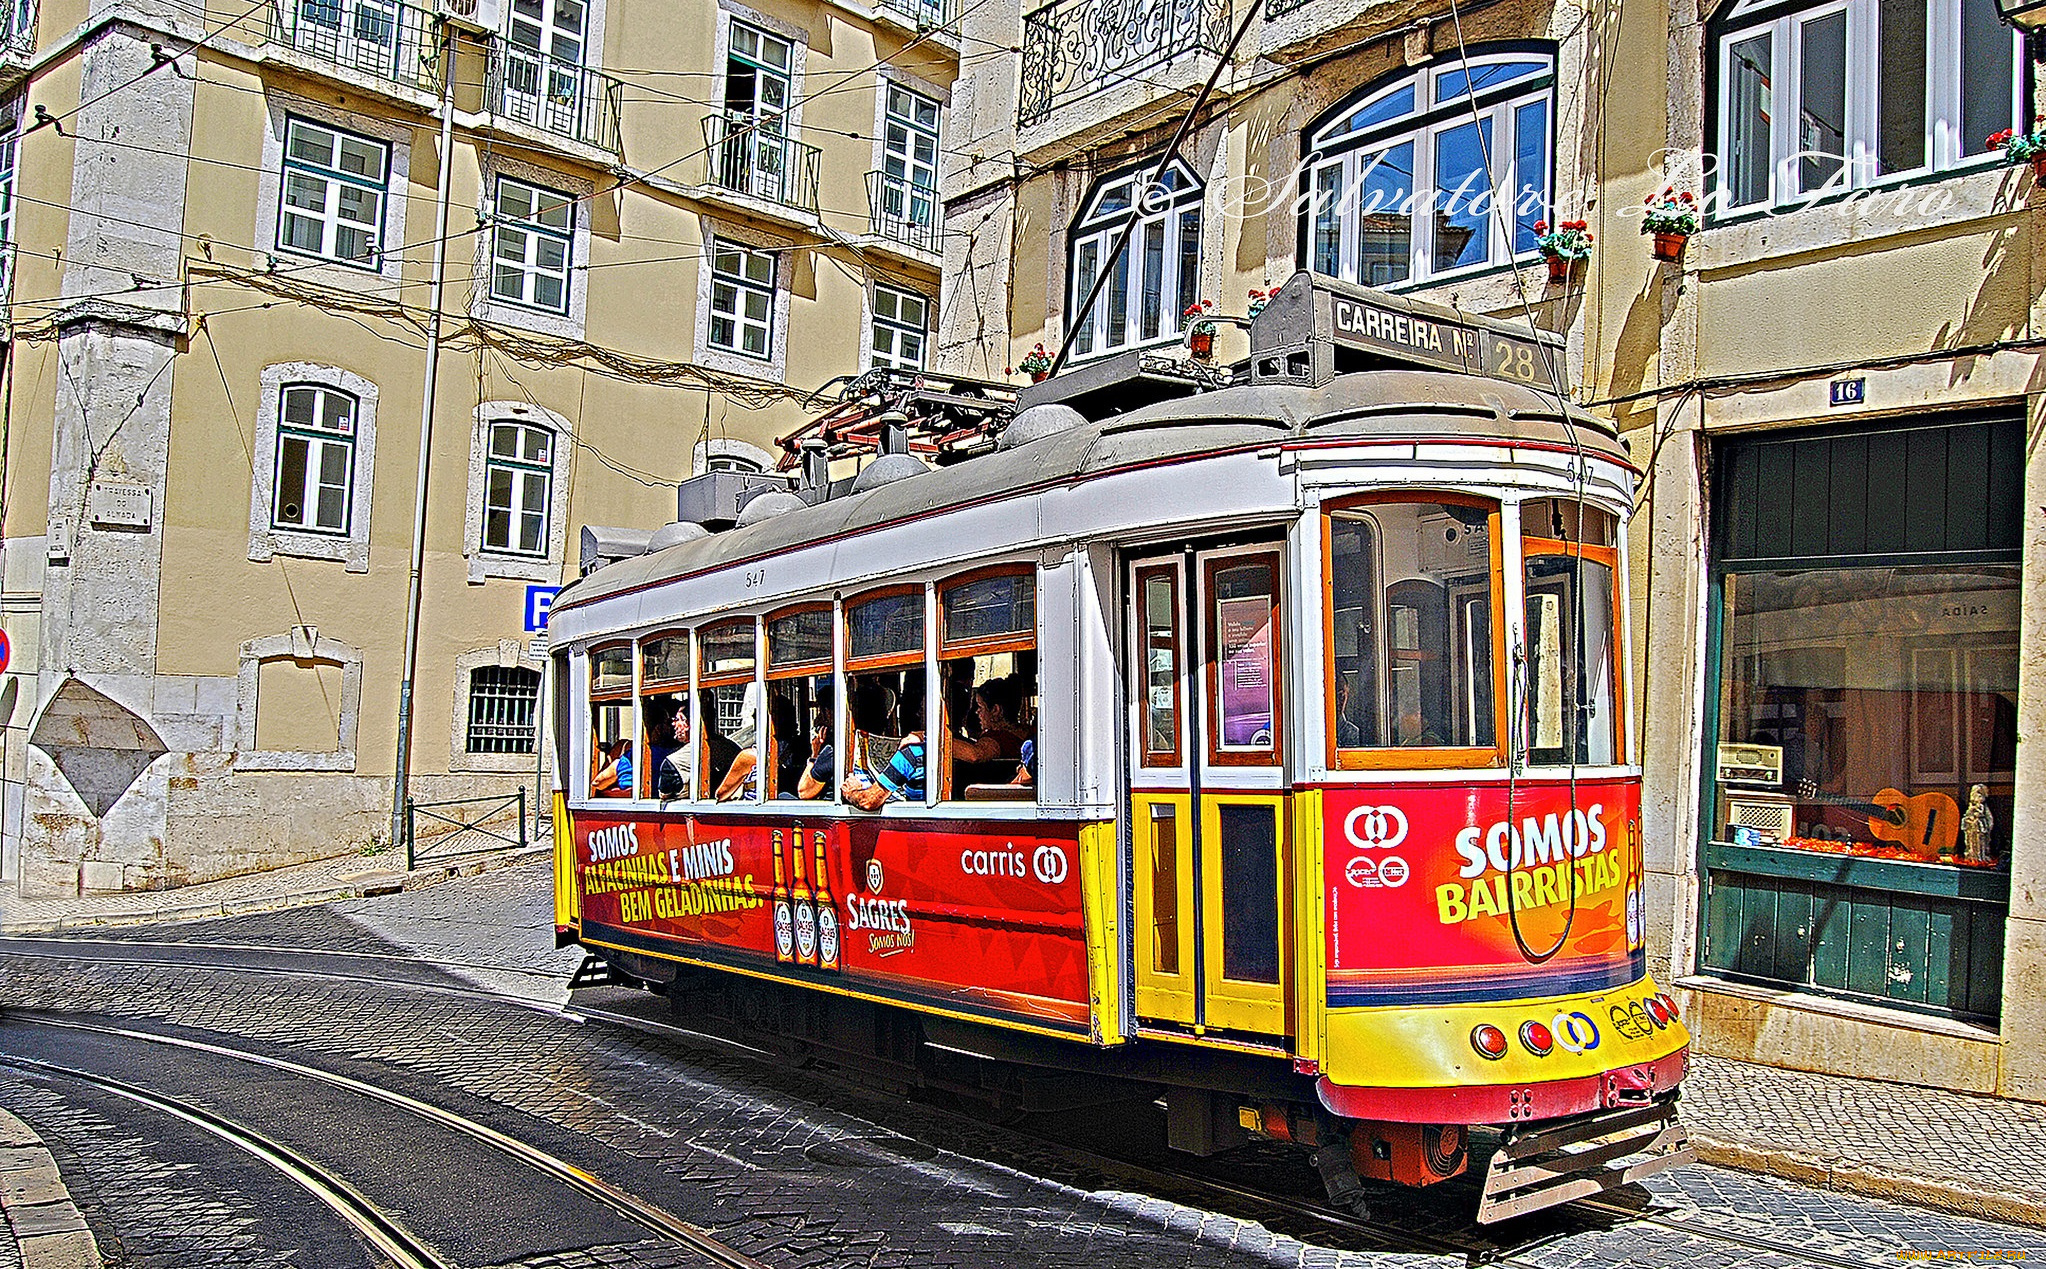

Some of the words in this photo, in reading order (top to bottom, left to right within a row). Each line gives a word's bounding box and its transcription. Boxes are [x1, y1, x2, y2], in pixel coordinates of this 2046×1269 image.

[1336, 301, 1443, 353] CARREIRA
[1496, 341, 1535, 383] 28
[1835, 381, 1857, 401] 16
[745, 569, 765, 588] 547
[532, 591, 555, 627] P
[588, 822, 639, 862] SOMOS
[961, 841, 1026, 878] carris
[1455, 803, 1606, 879] SOMOS
[584, 851, 668, 895] ALFACINHAS
[669, 848, 681, 882] E
[682, 838, 734, 880] MINIS
[1435, 848, 1621, 924] BAIRRISTAS
[619, 888, 653, 923] BEM
[846, 893, 912, 934] SAGRES
